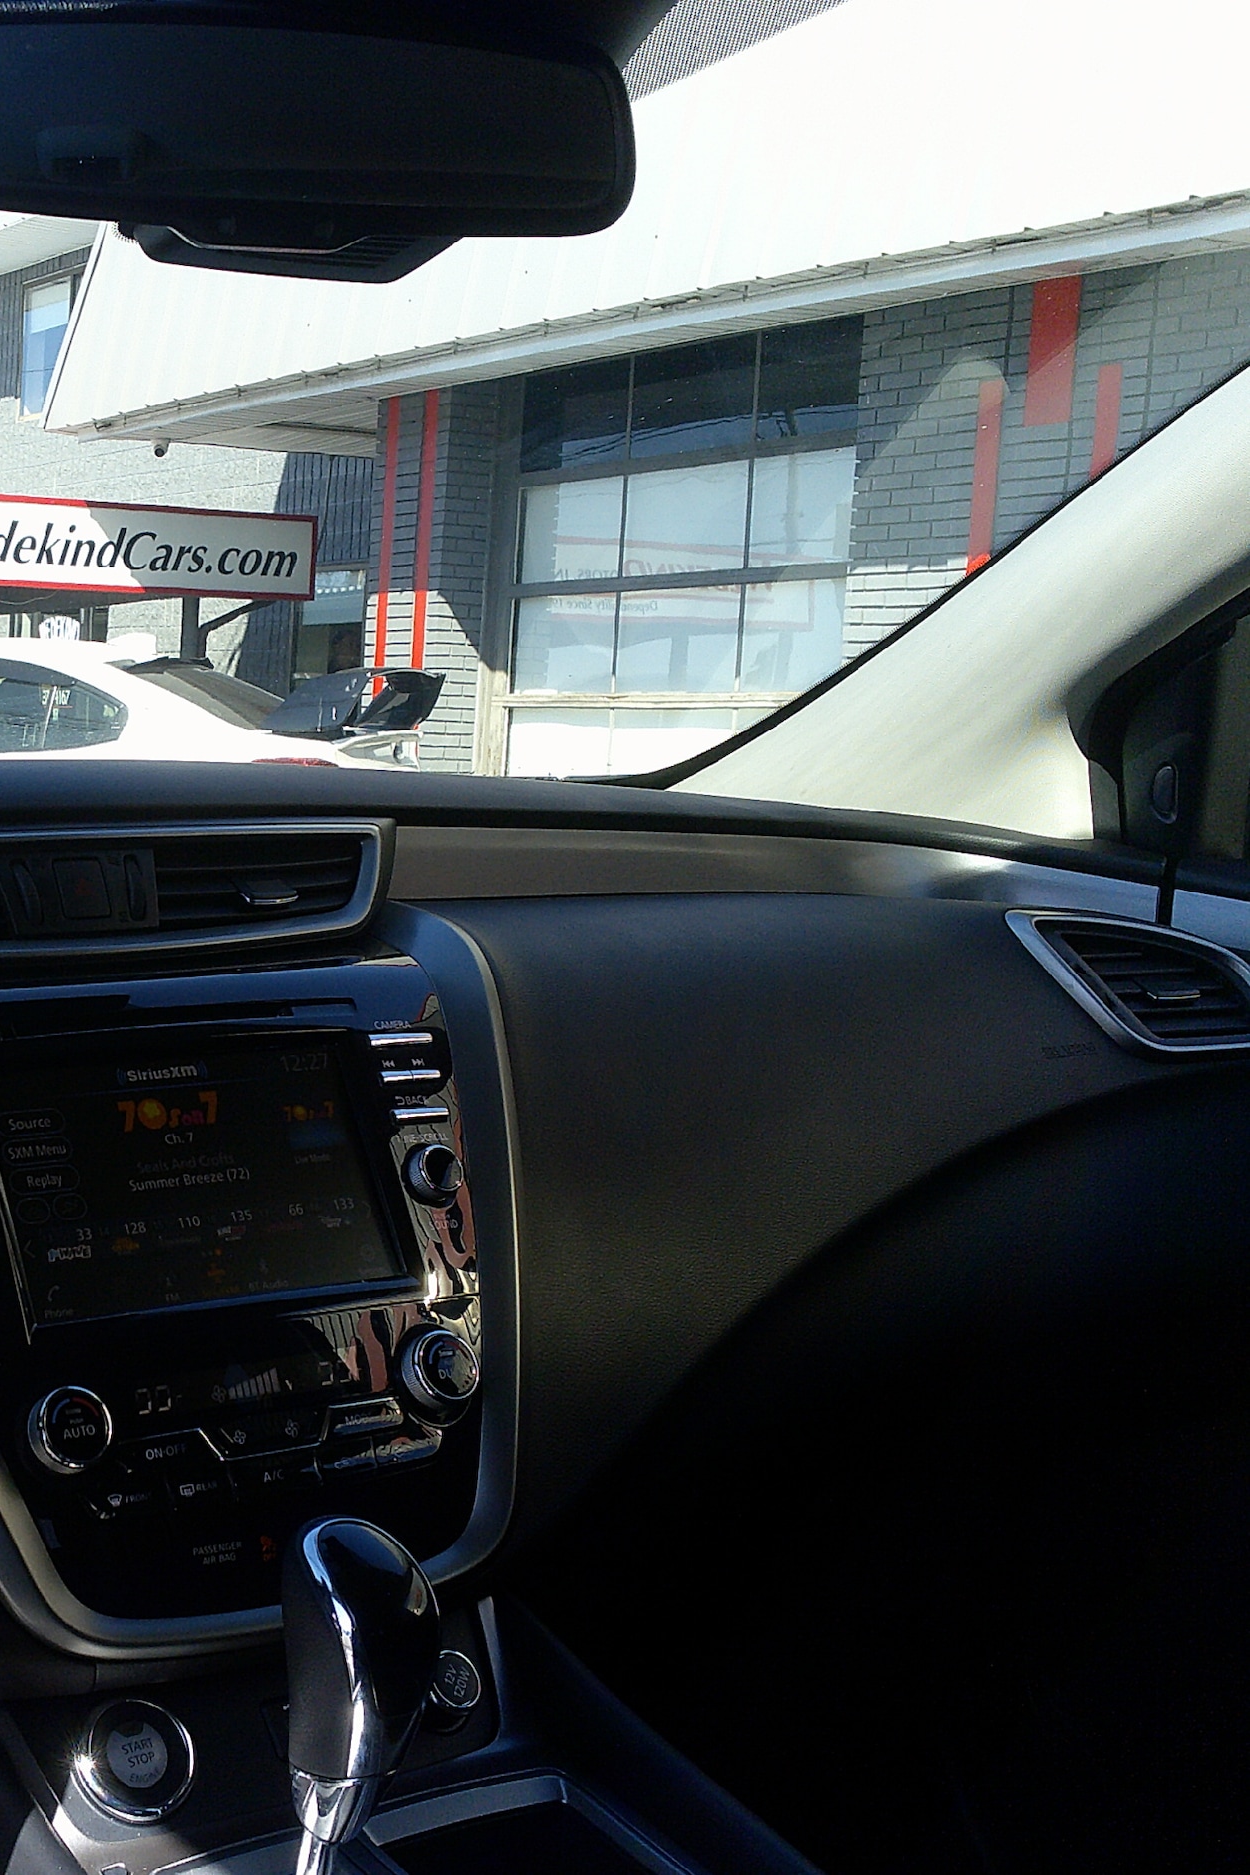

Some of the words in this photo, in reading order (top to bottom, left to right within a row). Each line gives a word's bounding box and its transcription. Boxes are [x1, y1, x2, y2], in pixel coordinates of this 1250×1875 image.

[374, 1019, 411, 1030] CAMERA
[280, 1053, 328, 1072] 12:27
[405, 1095, 429, 1106] BACK
[8, 1116, 52, 1131] Source
[164, 1132, 186, 1145] Ch.
[7, 1145, 34, 1160] SXM
[36, 1143, 67, 1157] Menu
[26, 1173, 62, 1189] Replay
[129, 1175, 180, 1192] Summer
[183, 1171, 224, 1186] Breeze
[226, 1167, 250, 1183] (72)
[288, 1203, 304, 1216] 66
[333, 1197, 355, 1211] 133
[178, 1215, 201, 1229] 110
[230, 1209, 252, 1223] 135
[76, 1227, 93, 1241] 33
[124, 1221, 147, 1235] 128
[63, 1424, 96, 1440] AUTO
[263, 1470, 285, 1483] A/C
[192, 1541, 243, 1557] PASSENGER
[202, 1554, 218, 1565] AIR
[219, 1552, 236, 1563] BAG
[444, 1663, 457, 1685] 12V
[454, 1666, 470, 1698] 120W
[121, 1738, 153, 1755] START
[128, 1751, 155, 1768] STOP
